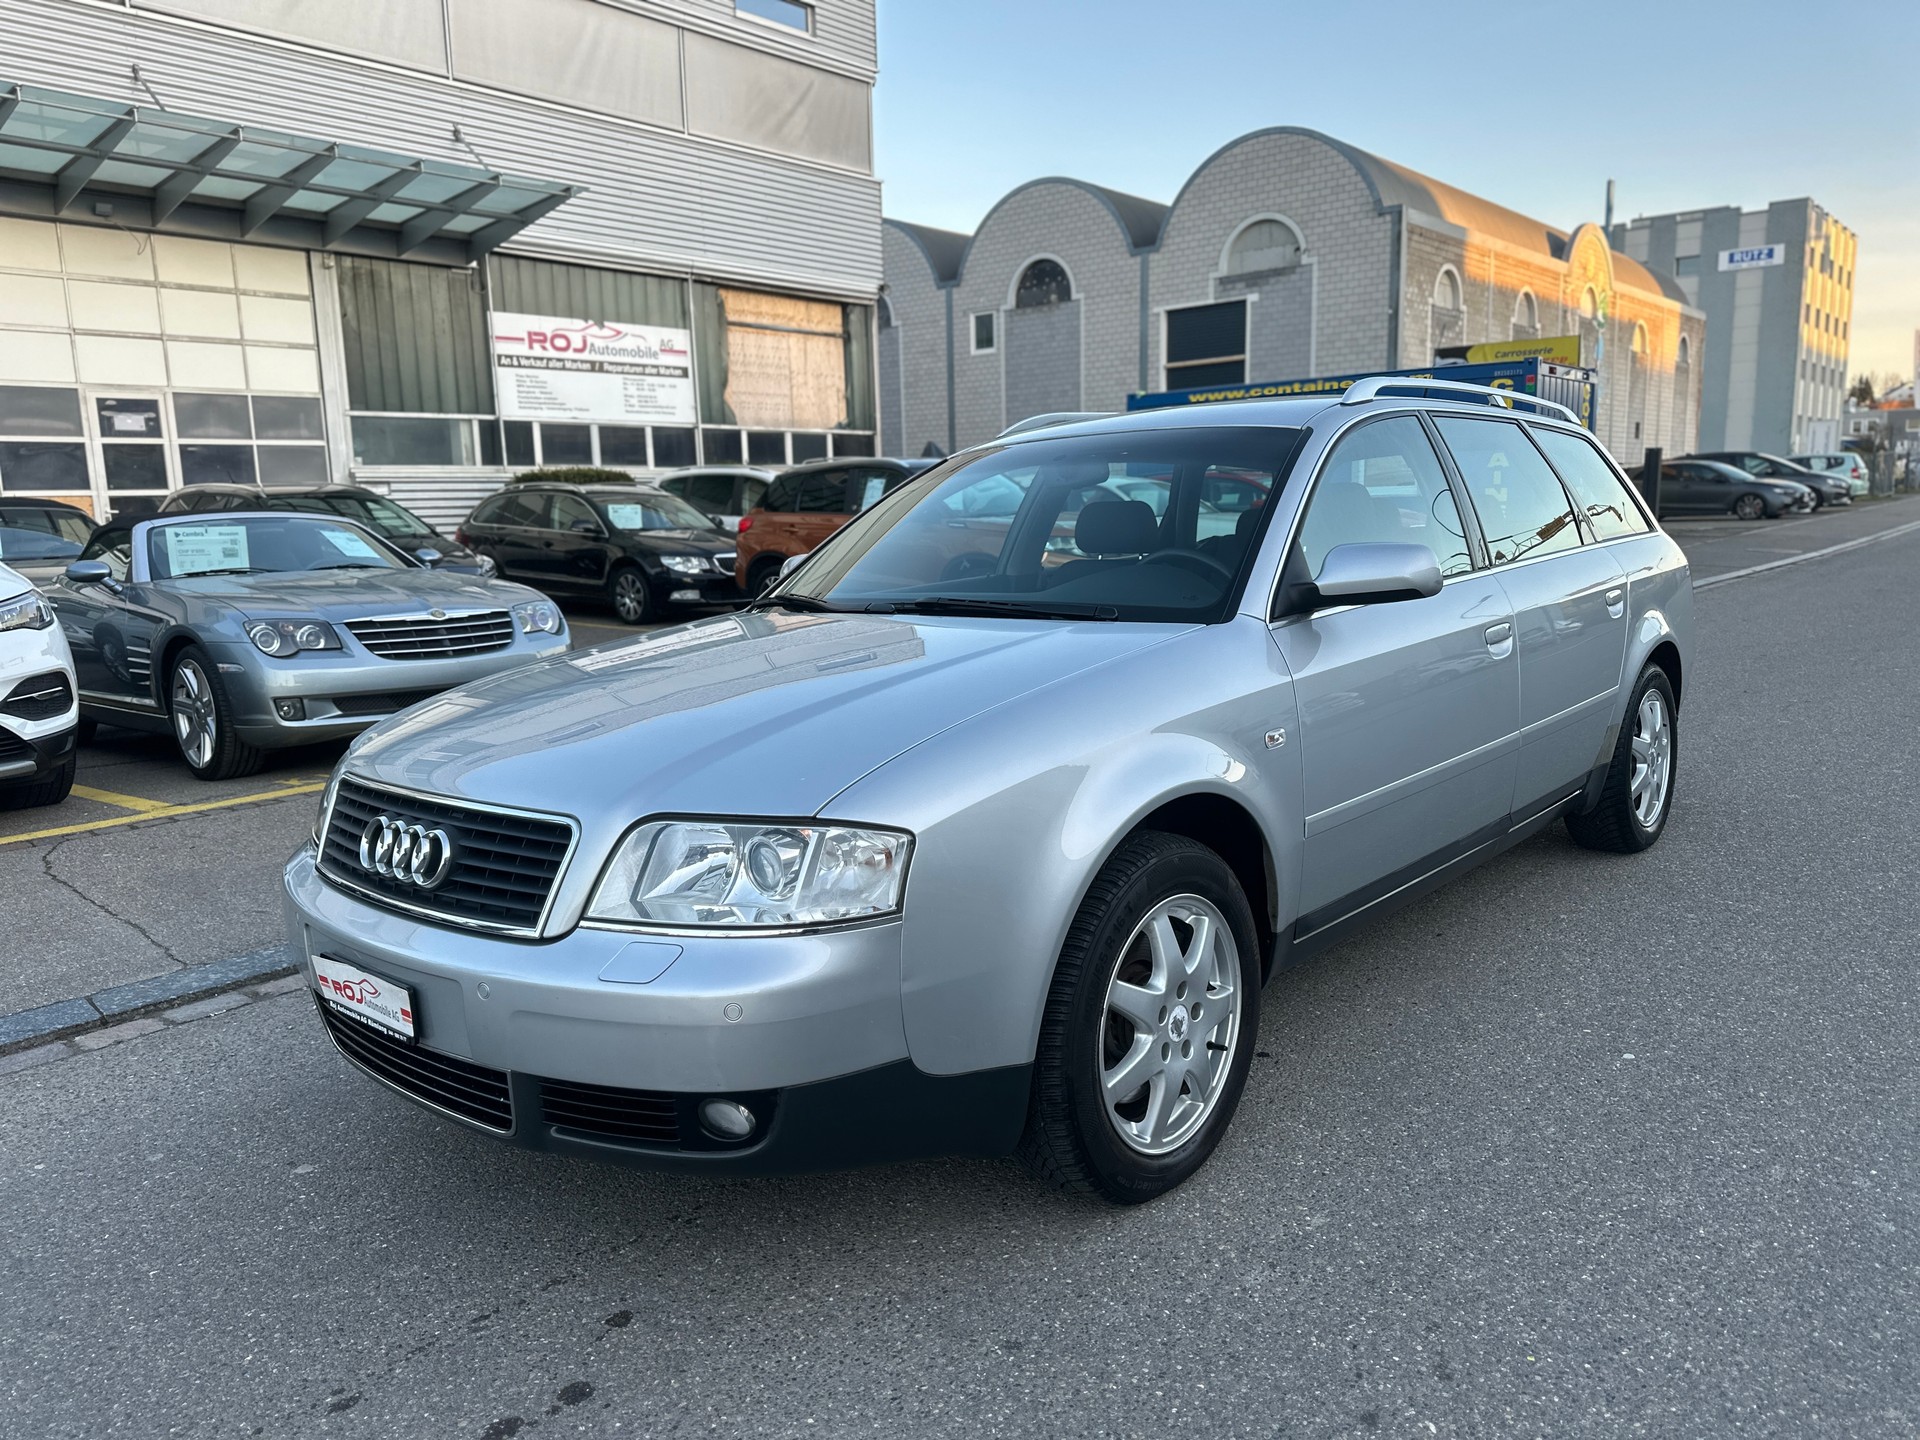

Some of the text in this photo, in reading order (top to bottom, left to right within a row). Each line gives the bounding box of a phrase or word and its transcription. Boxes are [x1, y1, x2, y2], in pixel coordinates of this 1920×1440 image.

[527, 331, 674, 360] ROJ Automobile AG
[519, 356, 547, 368] Verkauf
[564, 359, 592, 371] Marken
[331, 979, 365, 1005] ROJ
[364, 996, 392, 1019] Automobile
